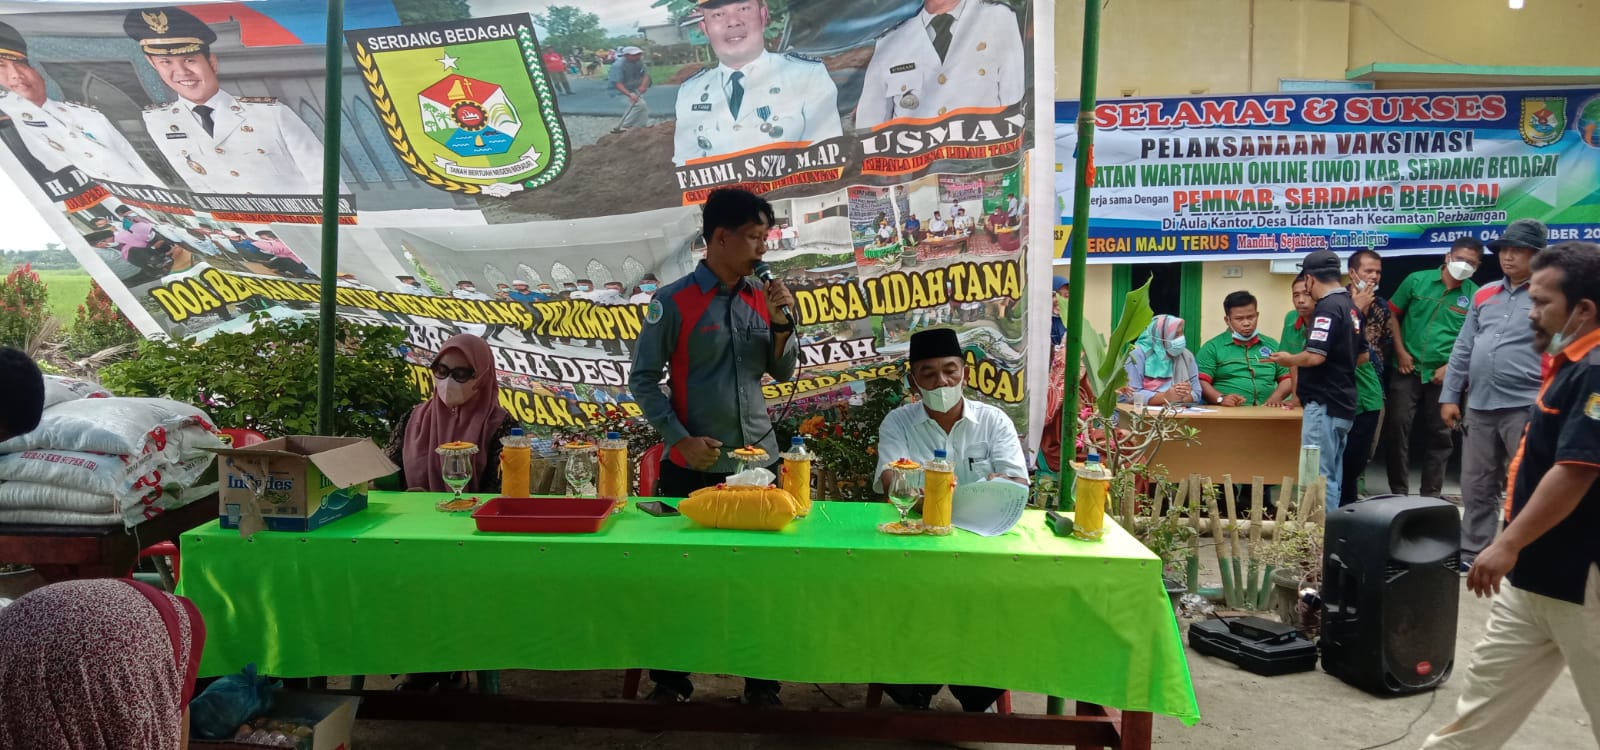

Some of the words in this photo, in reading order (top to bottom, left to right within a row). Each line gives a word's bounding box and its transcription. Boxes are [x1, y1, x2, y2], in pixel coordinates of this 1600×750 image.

[368, 30, 442, 51] SERDANG
[446, 23, 516, 43] BEDAGAI
[1094, 98, 1295, 129] SELAMAT
[1302, 98, 1338, 124] &
[1345, 95, 1506, 123] SUKSES
[1141, 133, 1325, 159] PELAKSANAAN
[1337, 131, 1474, 154] VAKSINASI
[676, 162, 743, 190] FAHMI,
[796, 143, 847, 168] M.AP.
[1094, 165, 1137, 188] ATAN
[1141, 162, 1243, 188] WARTAWAN
[1248, 160, 1308, 184] ONLINE
[1312, 159, 1361, 182] (IWO)
[1365, 158, 1405, 181] KAB.
[1408, 157, 1484, 180] SERDANG
[1487, 154, 1560, 178] BEDAGAI
[1110, 196, 1133, 206] sama
[1134, 194, 1169, 206] Dengan
[1173, 188, 1280, 214] PEMKAB.
[1284, 185, 1395, 213] SERDANG
[1401, 183, 1500, 210] BEDAGAI
[1162, 218, 1177, 230] Di
[1180, 218, 1207, 229] Aula
[1211, 217, 1252, 228] Kantor
[1257, 216, 1287, 227] Desa
[1290, 214, 1325, 226] Lidah
[1327, 213, 1364, 225] Tanah
[1367, 212, 1435, 224] Kecamatan
[1437, 210, 1507, 223] Perbaungan
[1086, 236, 1131, 253] ERGAI
[1136, 235, 1177, 252] MAJU
[1181, 234, 1230, 250] TERUS
[1330, 233, 1348, 246] dan
[1350, 232, 1389, 248] Religius
[153, 281, 221, 321] DOA
[382, 292, 533, 331] MENGENANG
[533, 299, 643, 340] PEMIMPIN
[796, 285, 867, 326] DESA
[867, 270, 947, 315] LIDAH
[762, 365, 897, 399] SERDANG
